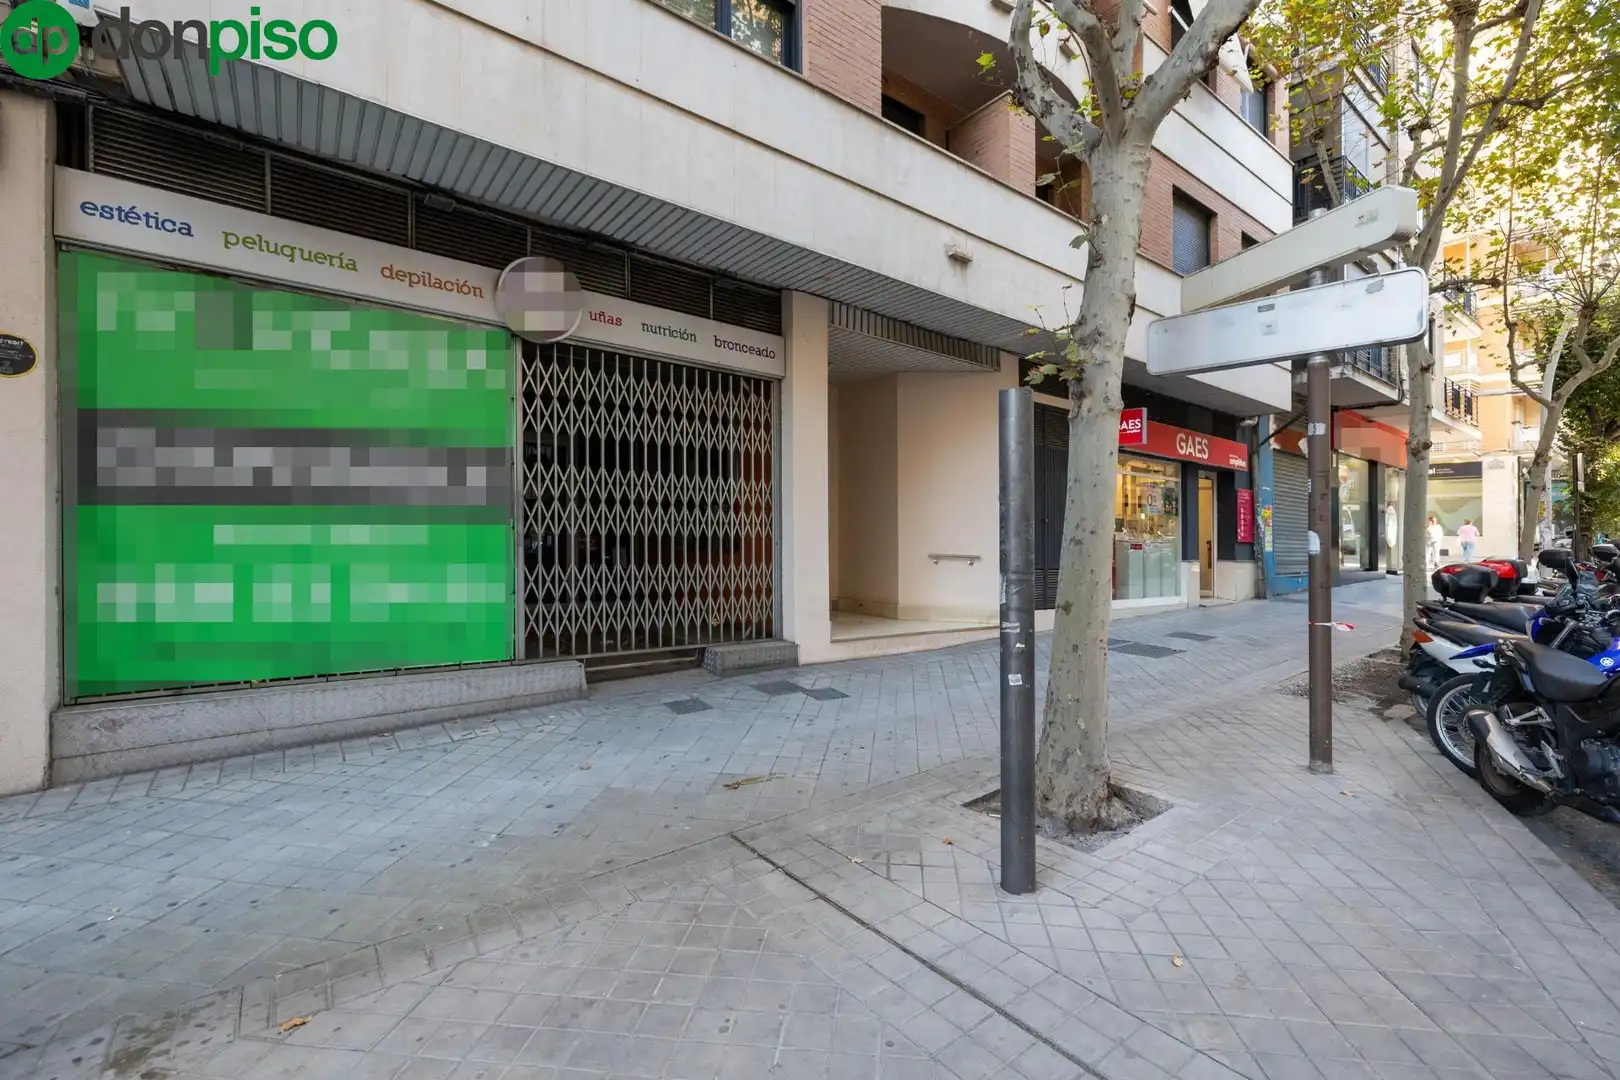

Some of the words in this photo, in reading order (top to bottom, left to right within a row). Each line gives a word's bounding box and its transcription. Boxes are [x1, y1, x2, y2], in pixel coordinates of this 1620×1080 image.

[80, 200, 194, 238] estética
[222, 230, 358, 273] peluquería
[380, 263, 484, 299] depilación
[589, 309, 622, 327] uñas
[641, 321, 698, 343] nutrición
[714, 334, 776, 360] bronceado
[1119, 419, 1141, 430] AES
[1176, 433, 1209, 459] GAES
